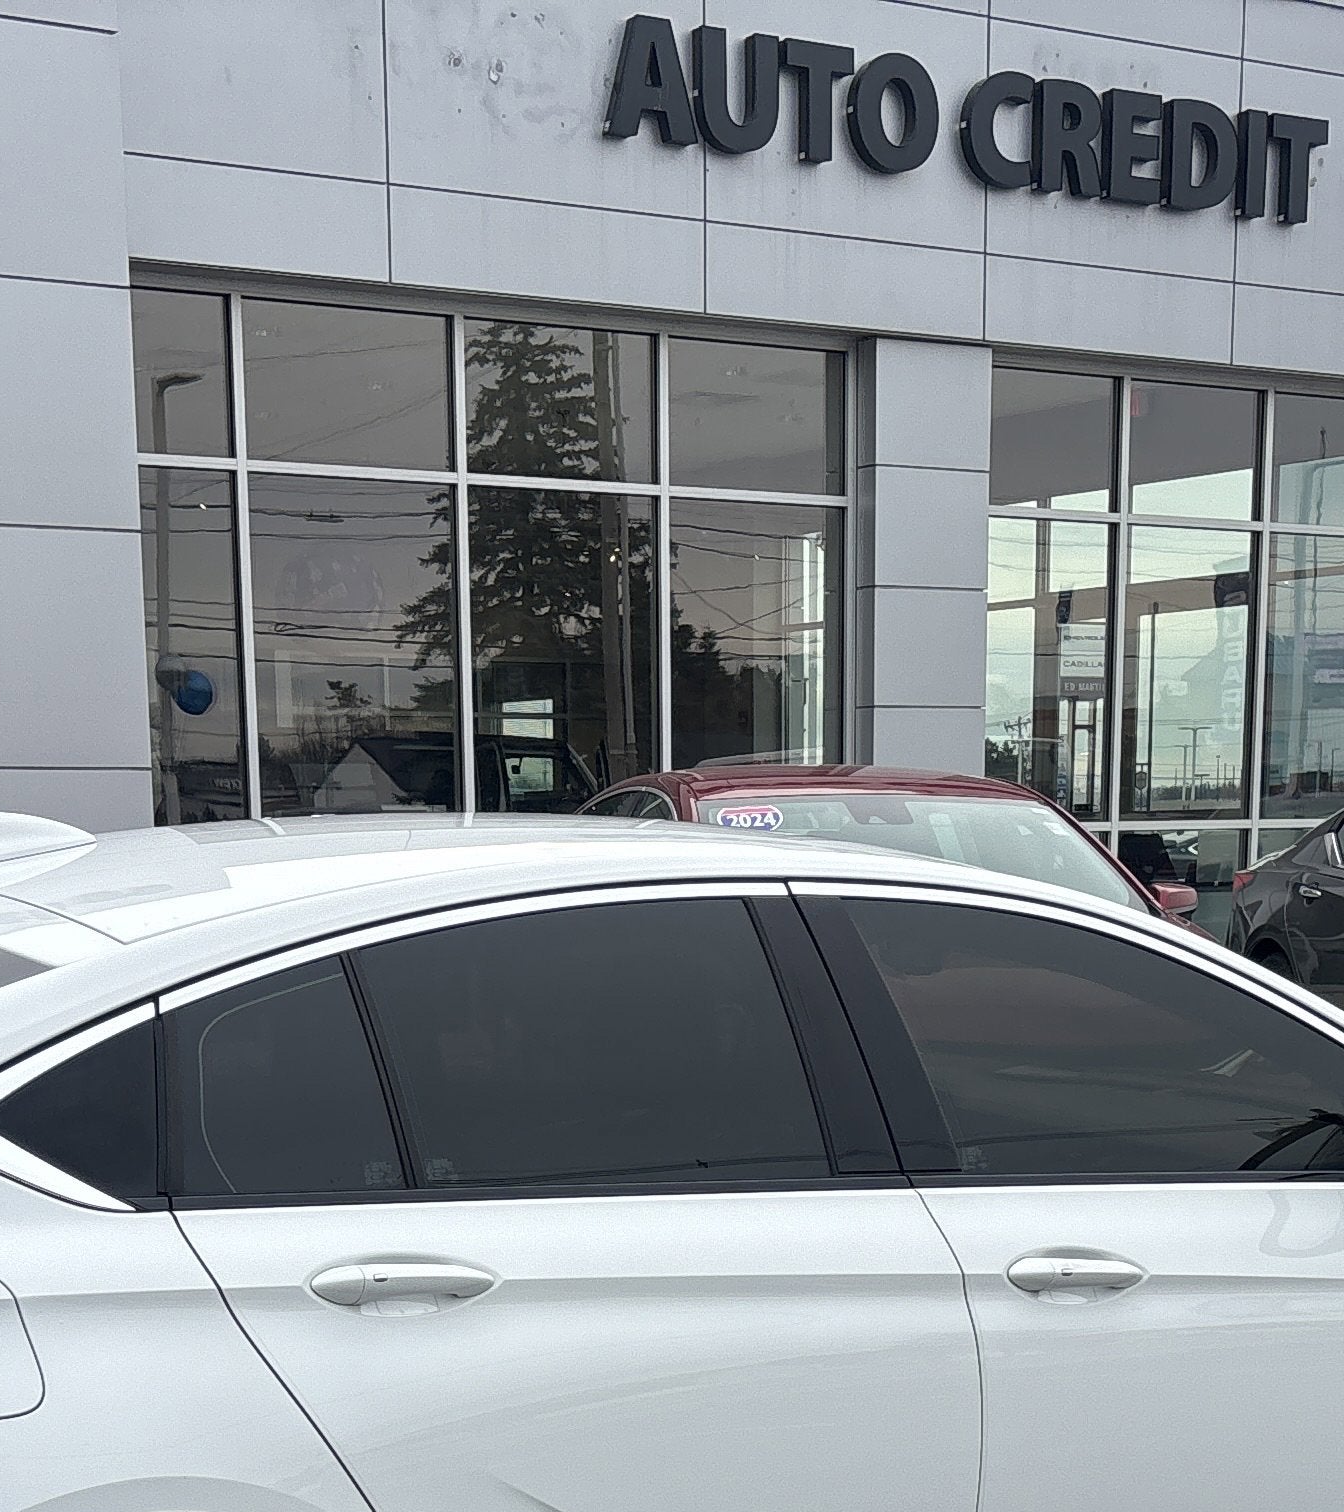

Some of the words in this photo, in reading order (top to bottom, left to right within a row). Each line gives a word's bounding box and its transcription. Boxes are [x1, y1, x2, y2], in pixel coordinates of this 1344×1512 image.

[602, 14, 939, 175] AUTO
[959, 70, 1329, 225] CREDIT
[726, 812, 776, 827] 2024
